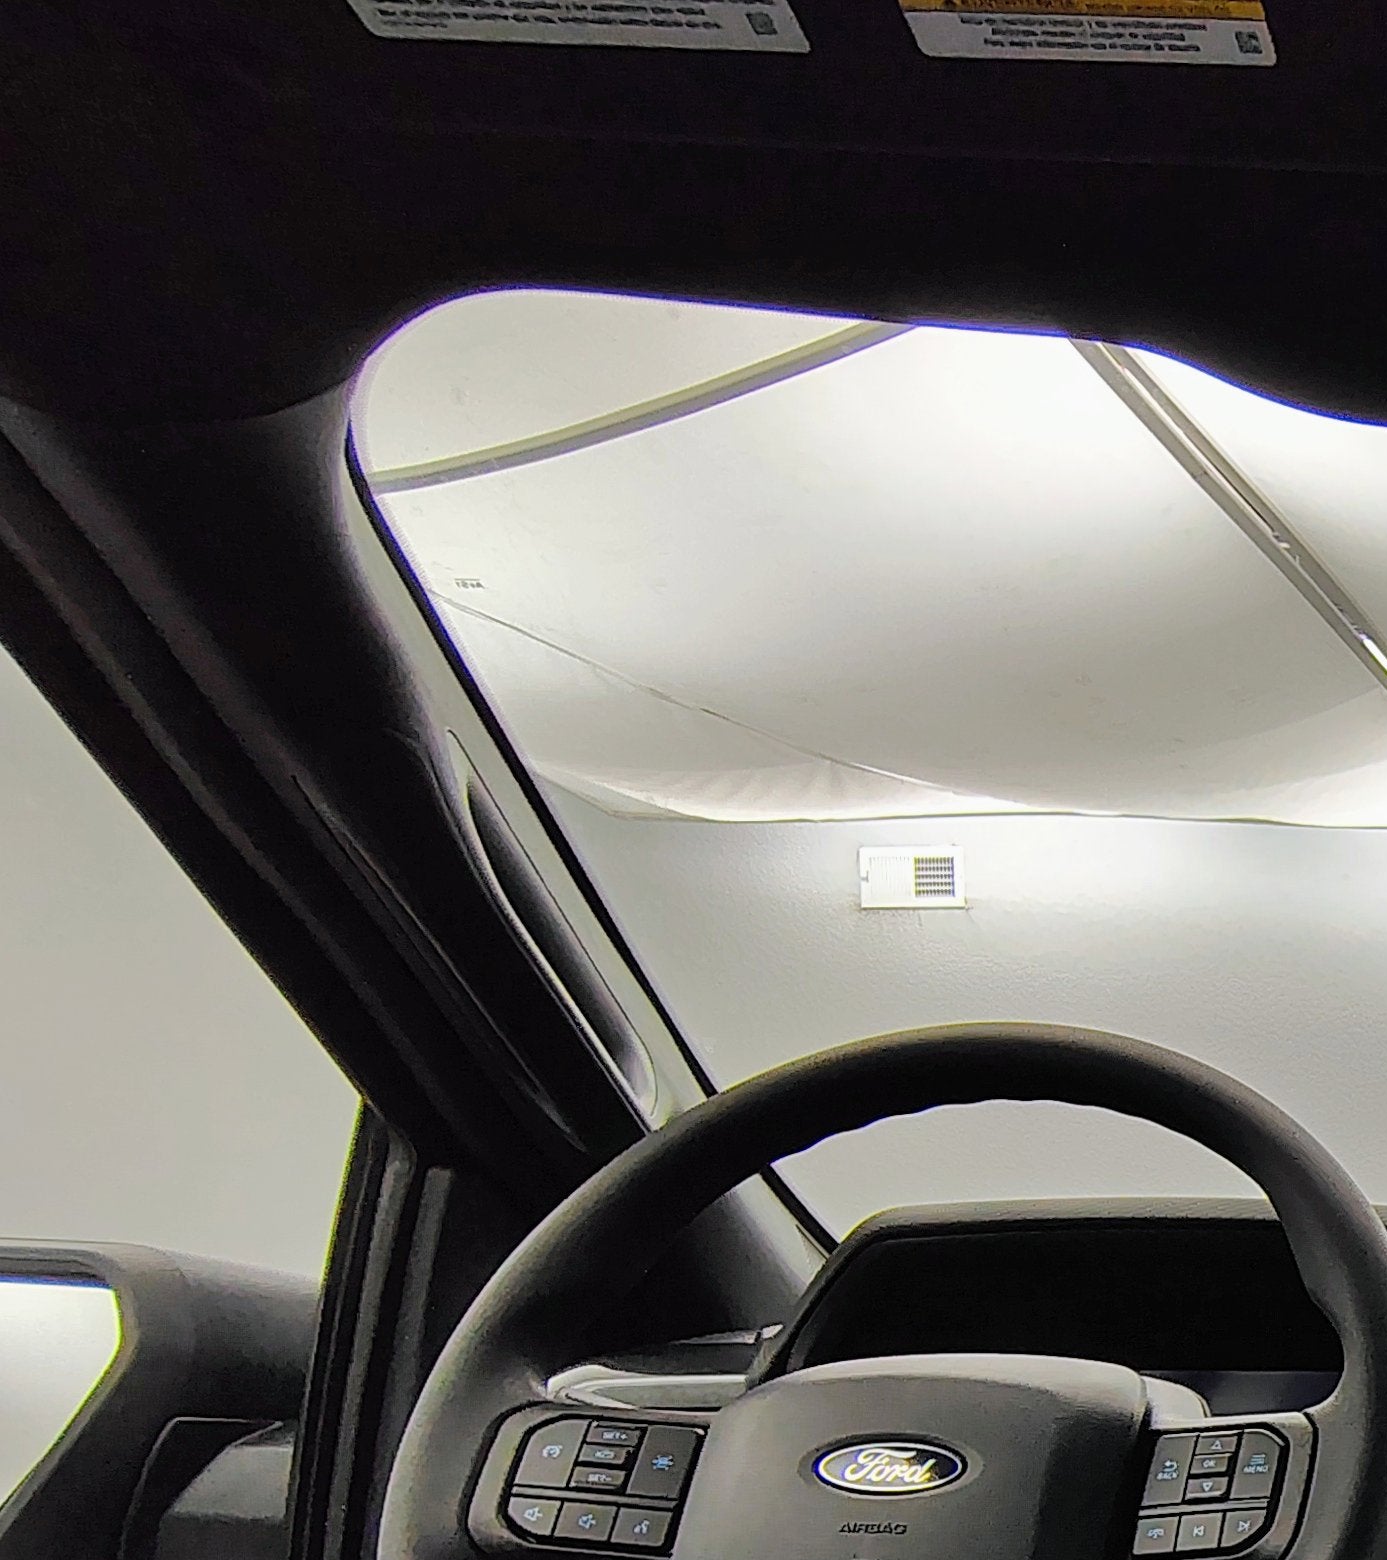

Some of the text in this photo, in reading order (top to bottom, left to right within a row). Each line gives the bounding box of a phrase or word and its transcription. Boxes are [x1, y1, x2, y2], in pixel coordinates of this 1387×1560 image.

[844, 1448, 937, 1483] Ford
[1202, 1460, 1216, 1468] OK
[1156, 1471, 1178, 1480] BACK
[838, 1522, 908, 1535] AIRBAG
